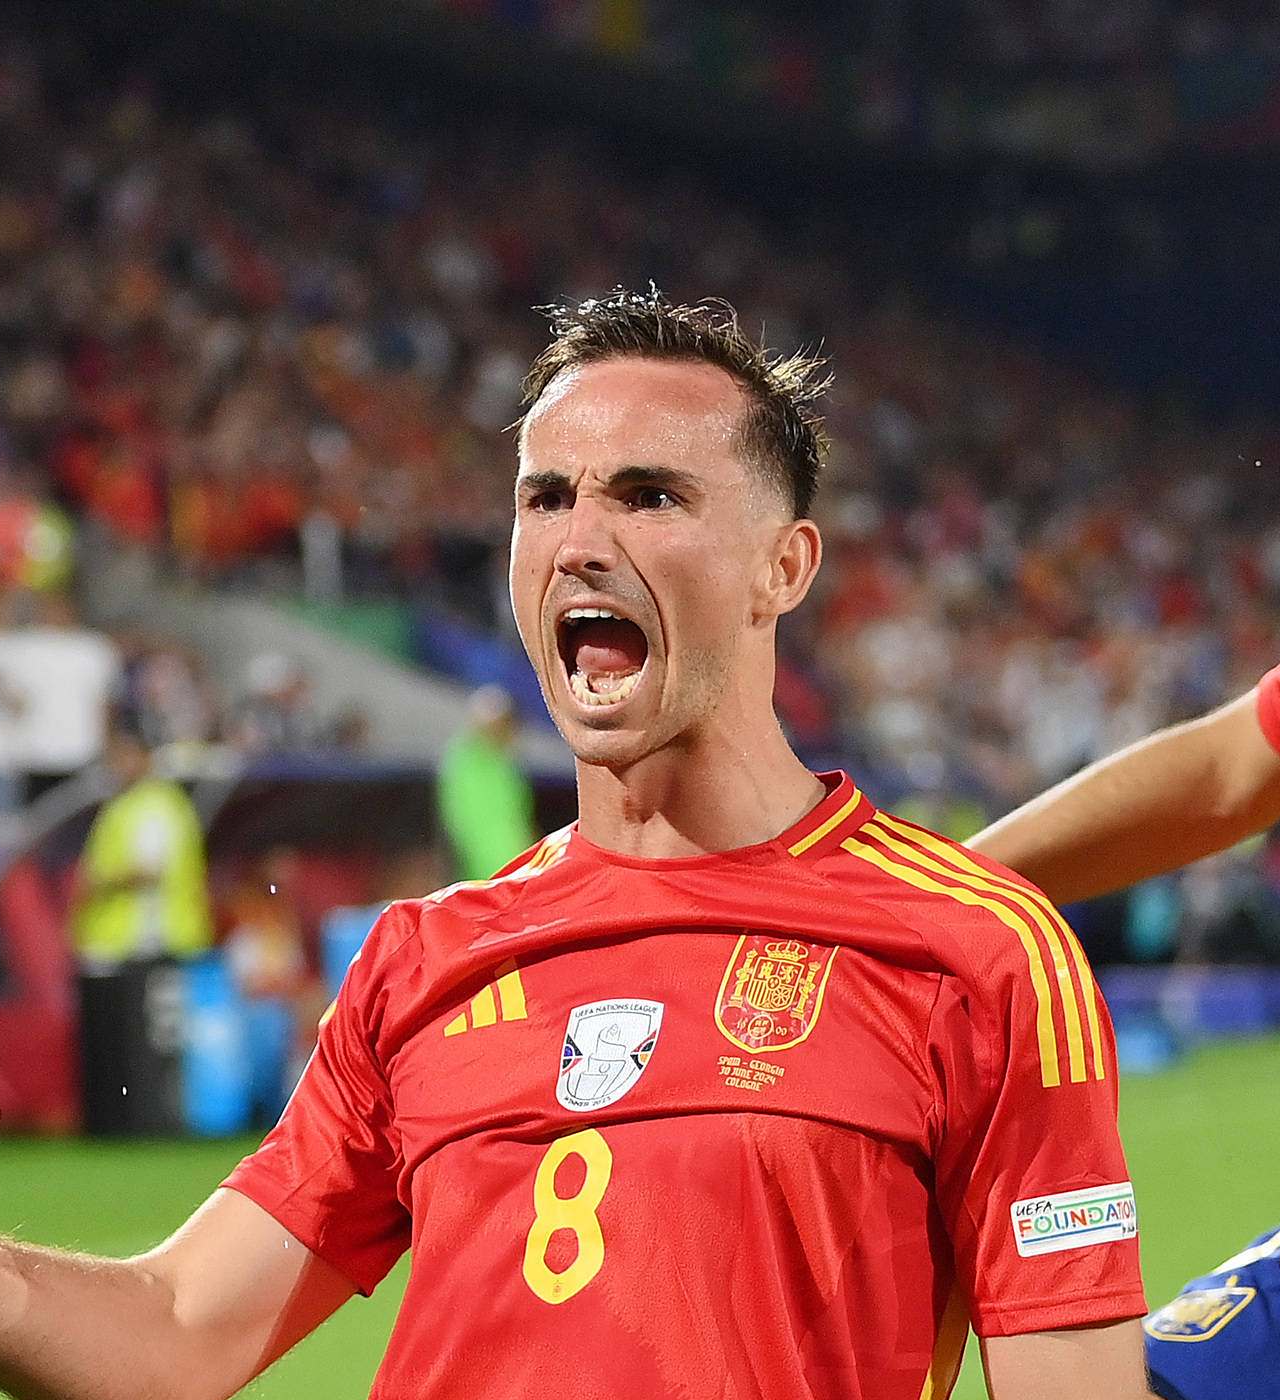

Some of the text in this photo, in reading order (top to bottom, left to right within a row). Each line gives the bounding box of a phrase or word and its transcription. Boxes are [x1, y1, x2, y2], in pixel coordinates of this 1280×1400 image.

[596, 1003, 628, 1013] NATIONS
[630, 1004, 657, 1014] LEAGUE
[719, 1066, 776, 1086] 30 JUNE 2024
[750, 1060, 786, 1078] GEORGIA
[725, 1077, 763, 1092] COLOGNE
[523, 1127, 613, 1305] 8
[1016, 1200, 1052, 1217] UEFA
